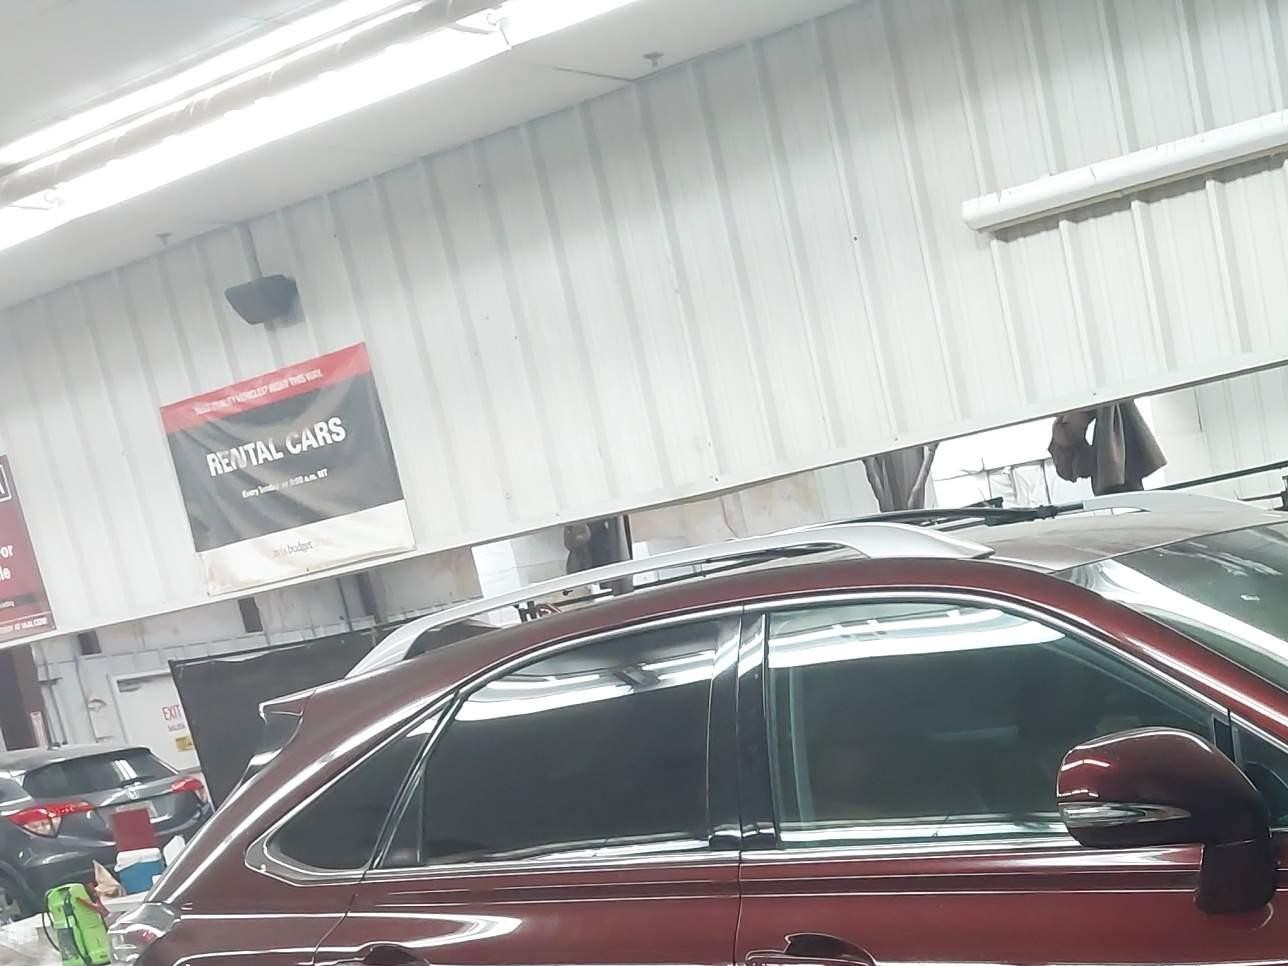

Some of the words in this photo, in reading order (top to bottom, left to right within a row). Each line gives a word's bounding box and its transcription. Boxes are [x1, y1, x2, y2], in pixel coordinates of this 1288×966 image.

[206, 437, 284, 477] RENTAL
[285, 416, 346, 455] CARS
[161, 704, 182, 721] EXIT
